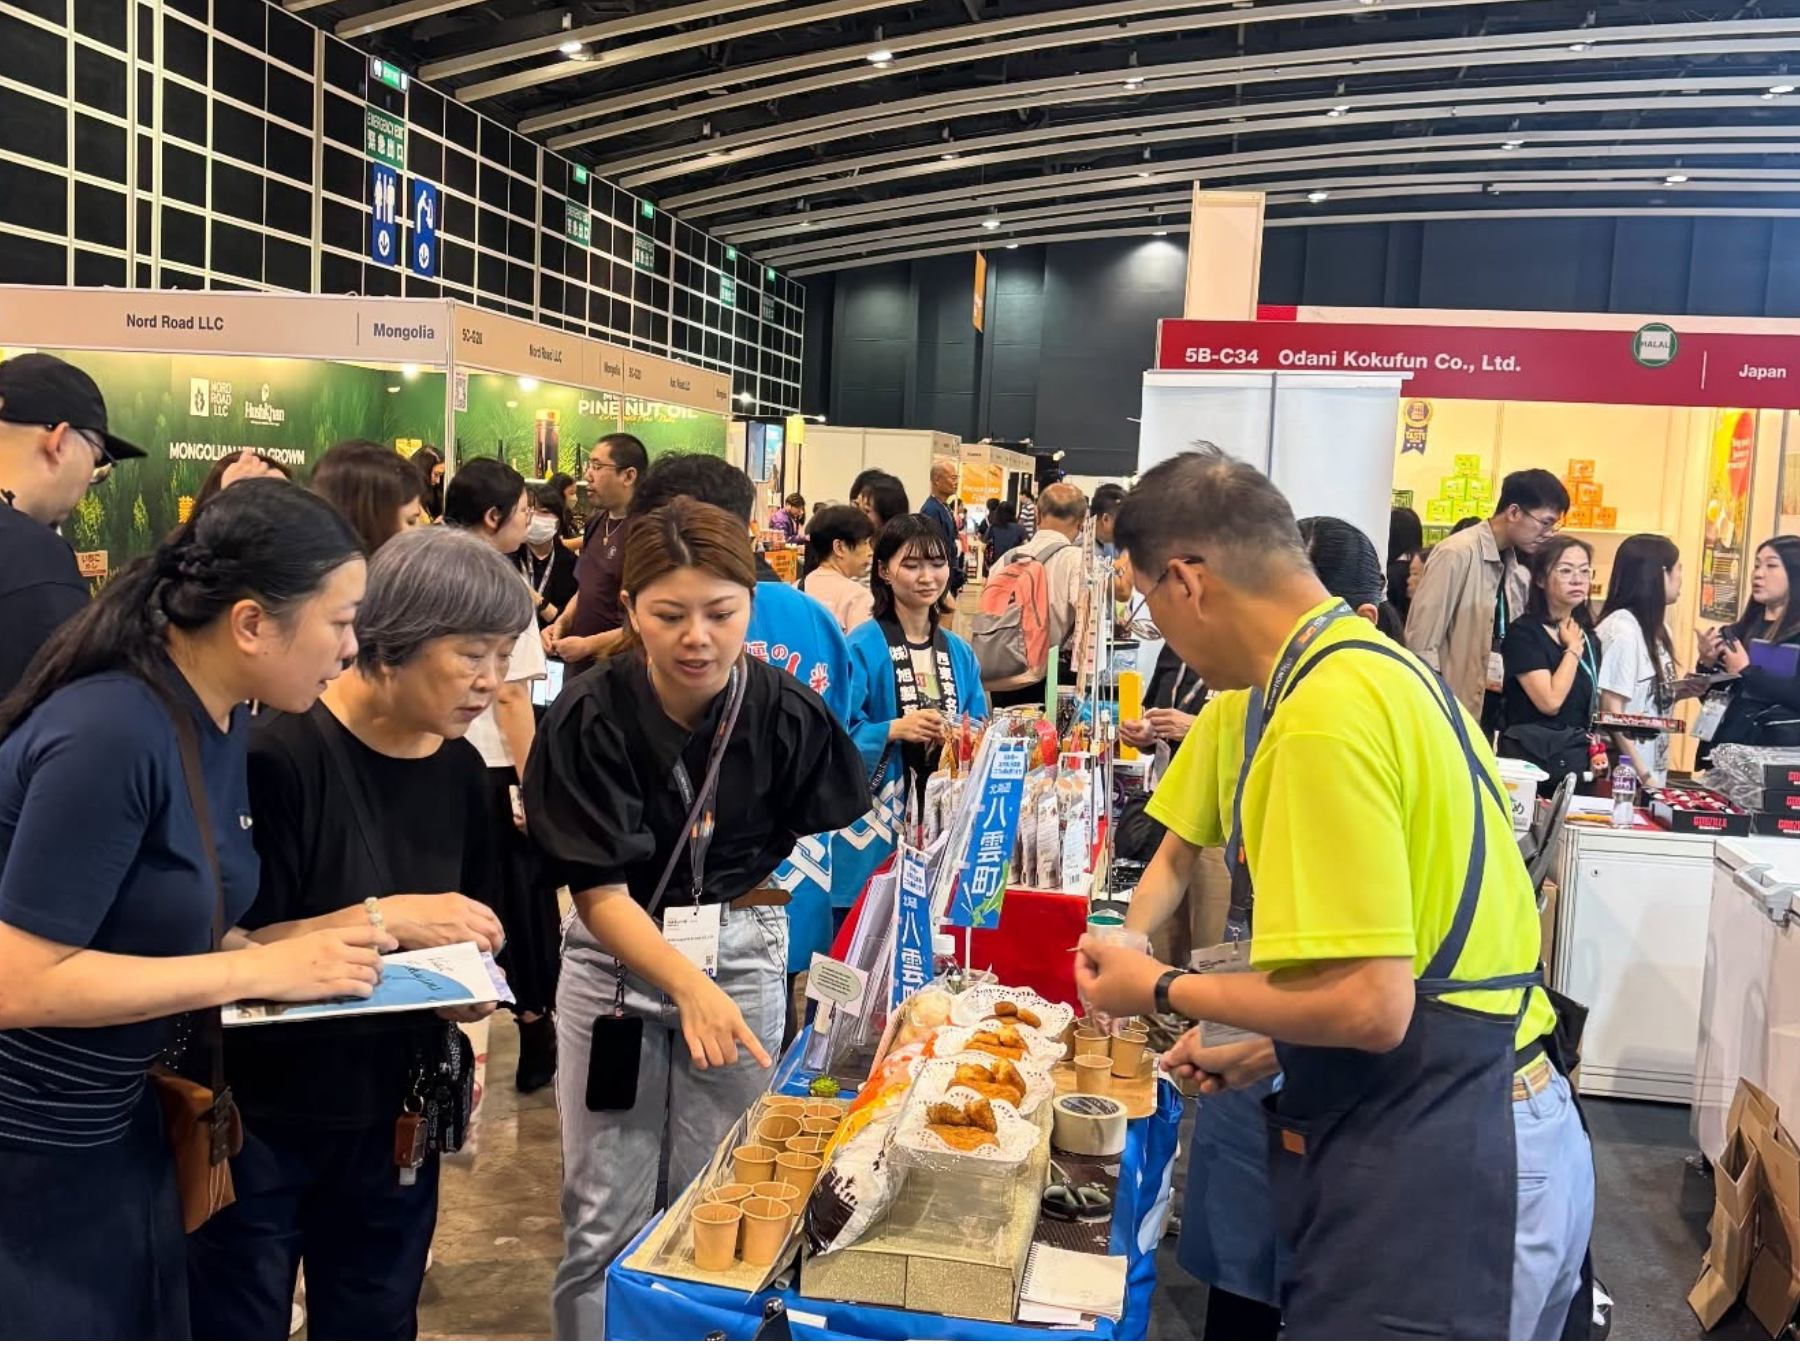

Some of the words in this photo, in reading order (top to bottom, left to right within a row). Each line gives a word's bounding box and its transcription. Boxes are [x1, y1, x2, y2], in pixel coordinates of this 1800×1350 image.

[126, 313, 157, 328] Nord
[161, 314, 194, 330] Road
[198, 316, 224, 331] LLC
[373, 322, 435, 341] Mongolia
[1640, 340, 1671, 350] HALAL
[1185, 347, 1259, 364] 5B-C34
[1278, 349, 1337, 367] Odani
[1343, 350, 1428, 369] Kokufun
[1435, 353, 1475, 373] Co.,
[1482, 354, 1522, 372] Ltd.
[1739, 363, 1788, 381] Japan
[210, 380, 232, 394] NORD
[210, 393, 232, 405] ROAD
[213, 405, 229, 417] LLC
[578, 400, 618, 415] PINE
[625, 402, 661, 417] NUT
[971, 797, 1007, 897] 八雲町
